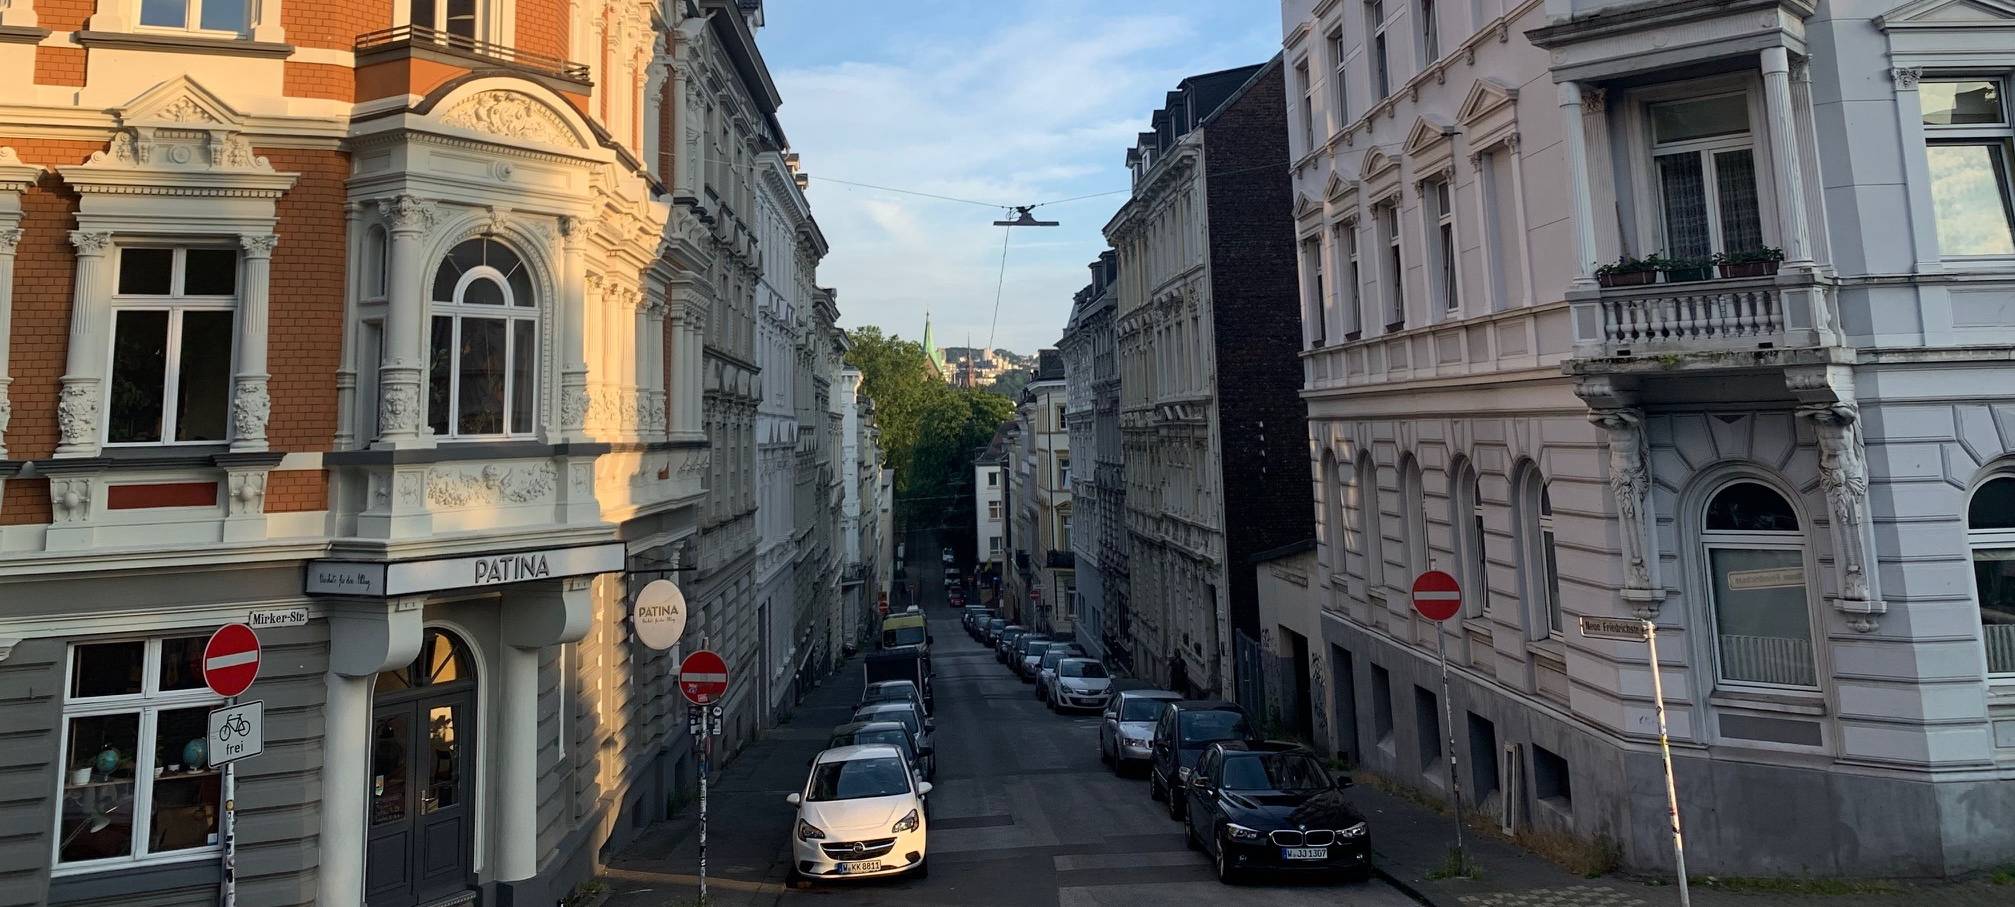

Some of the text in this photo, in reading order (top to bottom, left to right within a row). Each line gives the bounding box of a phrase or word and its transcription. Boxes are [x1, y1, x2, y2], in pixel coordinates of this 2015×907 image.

[475, 554, 550, 584] PATINA
[253, 611, 305, 625] Mirker-Str.
[639, 605, 679, 618] PATINA
[226, 740, 244, 755] frei
